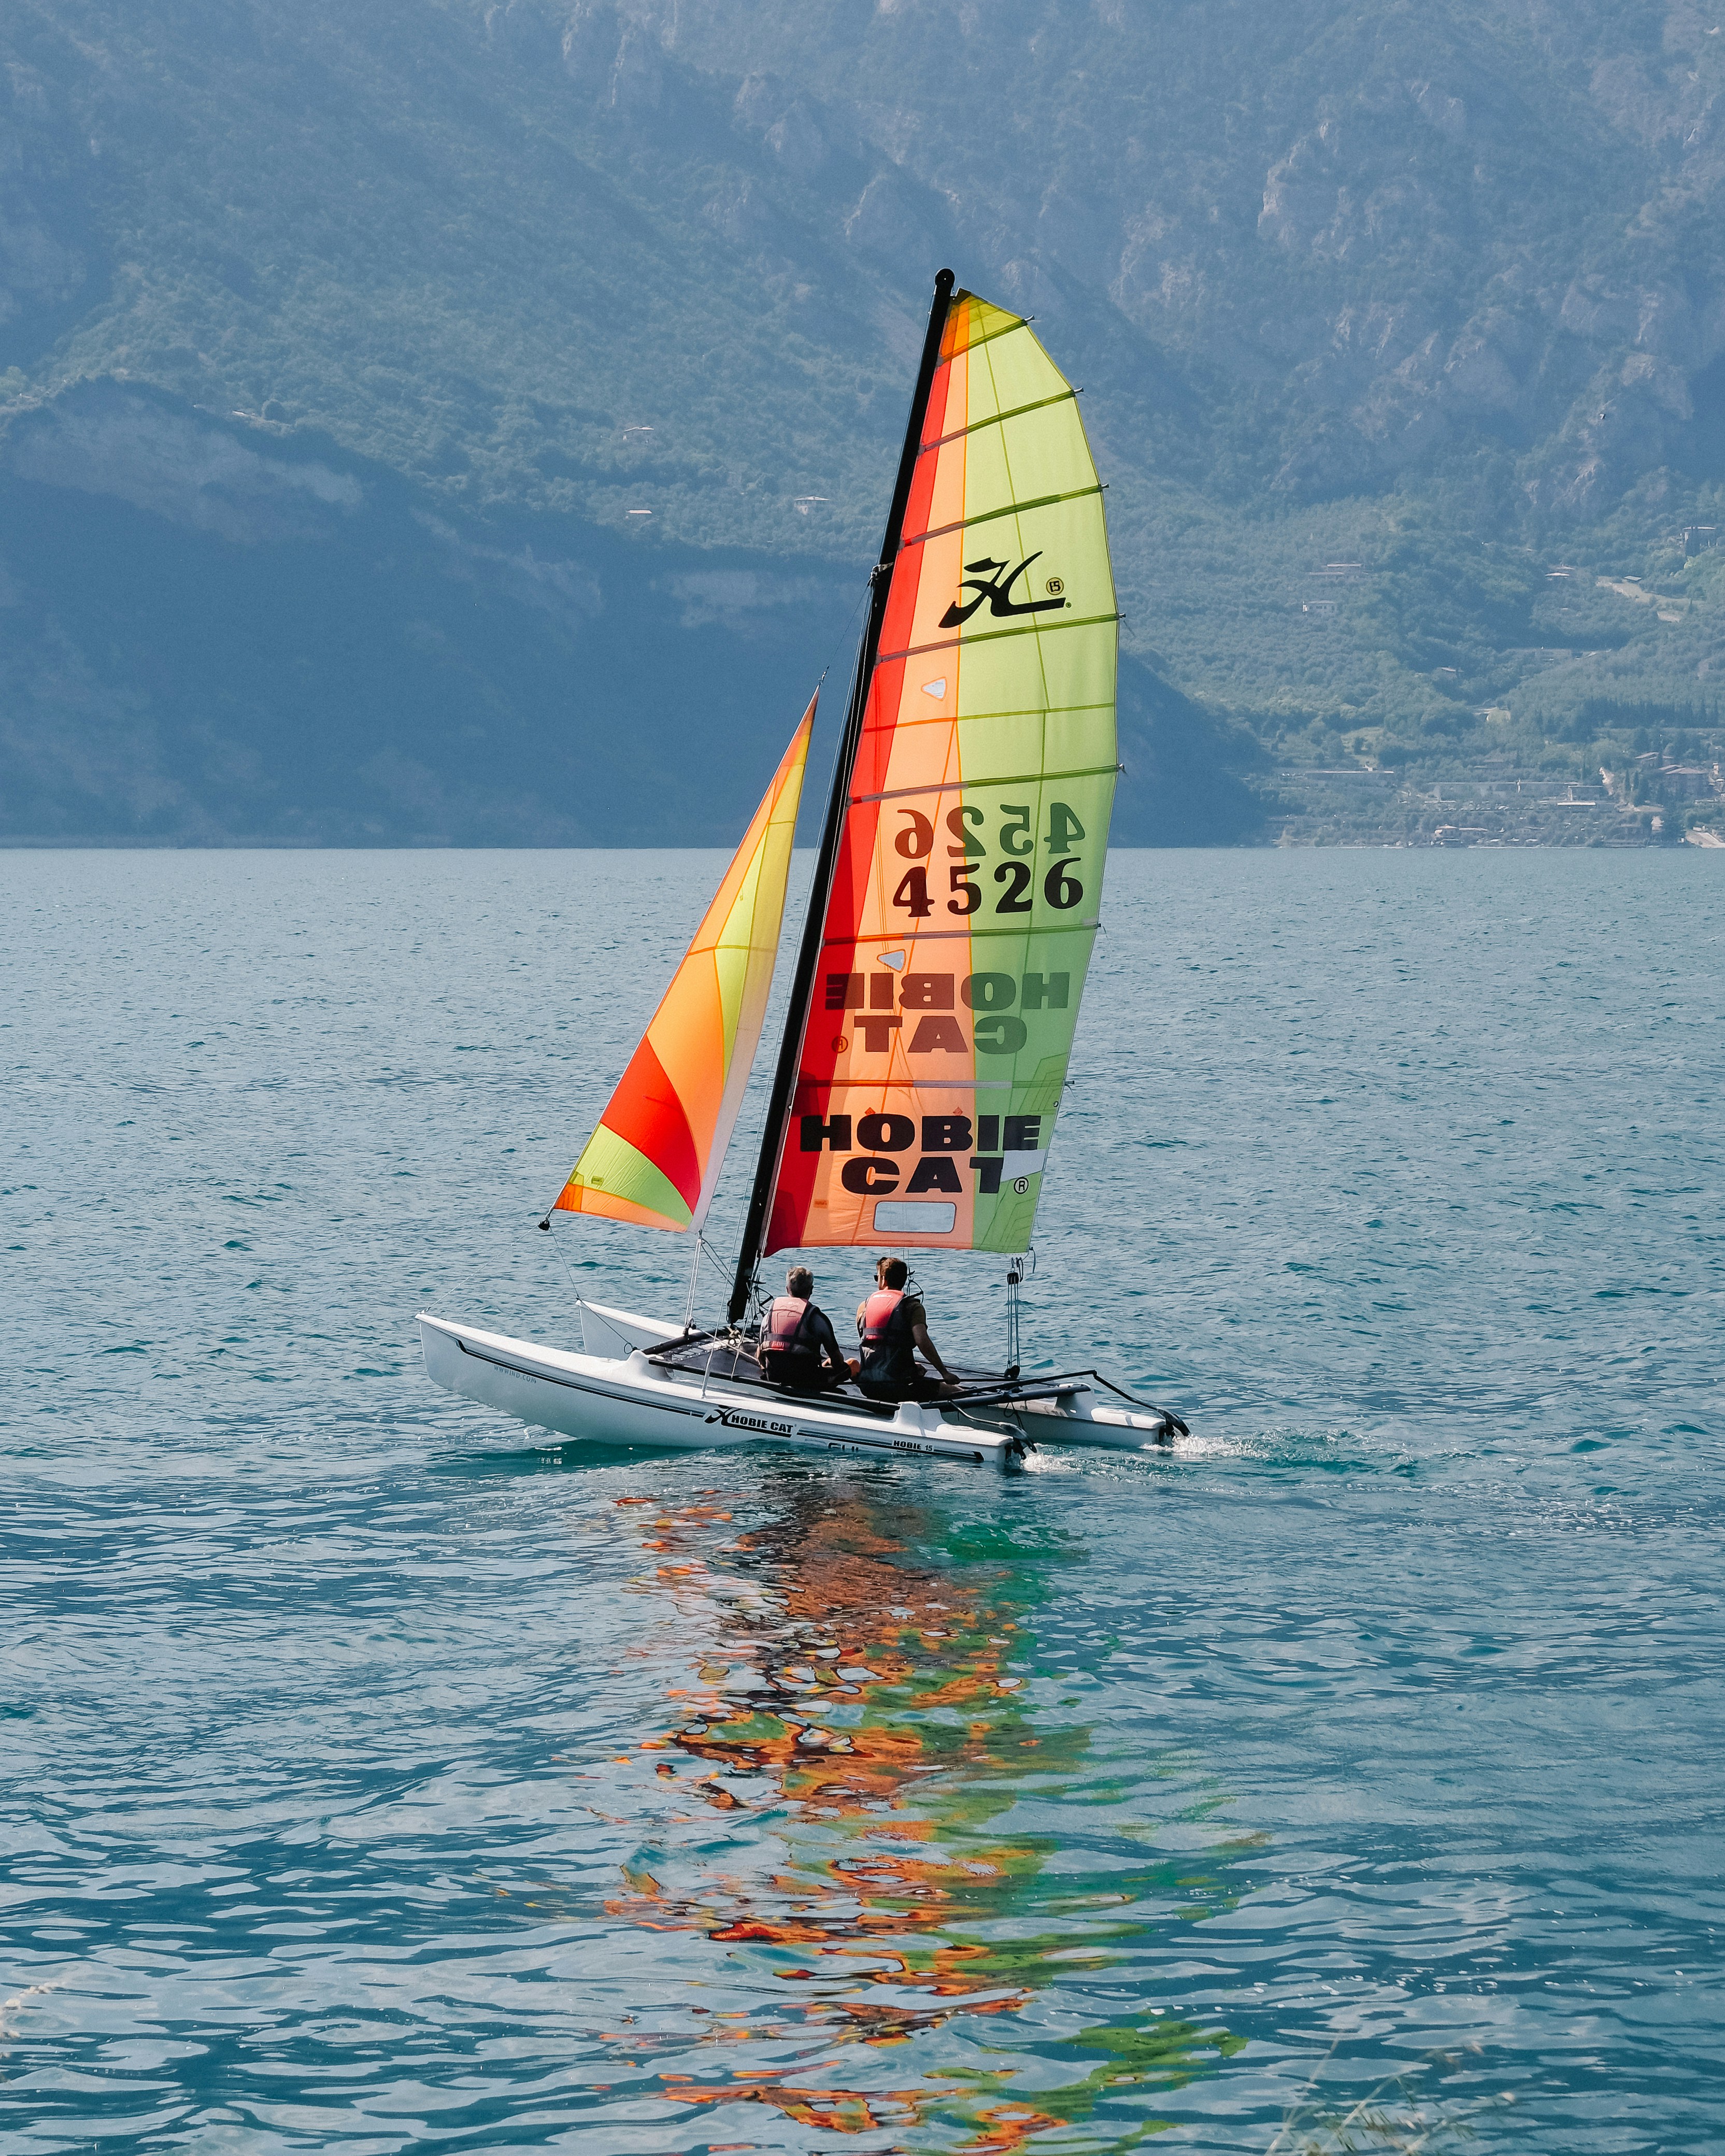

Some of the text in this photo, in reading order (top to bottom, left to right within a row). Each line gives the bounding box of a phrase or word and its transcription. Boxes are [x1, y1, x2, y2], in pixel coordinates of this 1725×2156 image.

[892, 857, 1084, 918] 4526
[801, 1113, 1042, 1152] HOBIE
[841, 1156, 1004, 1195] CAT
[731, 1415, 794, 1433] HOBIE CAT
[893, 1440, 921, 1450] HOBIE
